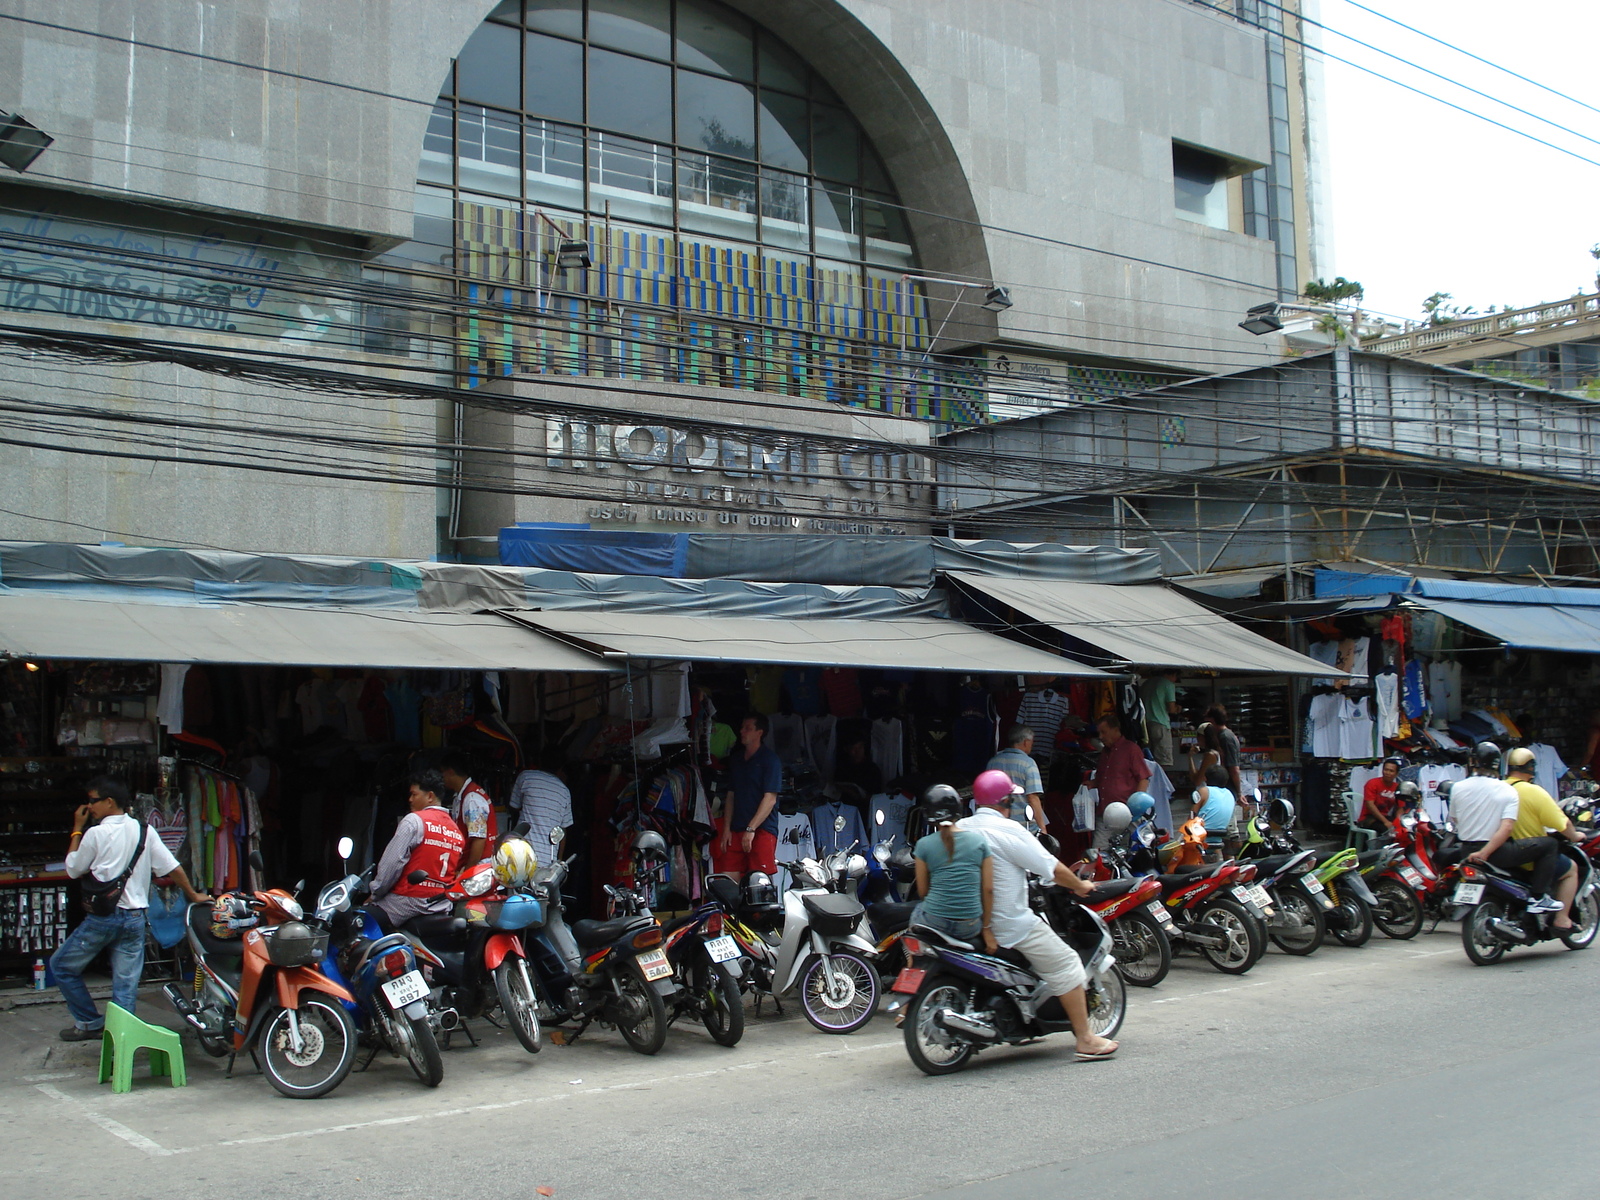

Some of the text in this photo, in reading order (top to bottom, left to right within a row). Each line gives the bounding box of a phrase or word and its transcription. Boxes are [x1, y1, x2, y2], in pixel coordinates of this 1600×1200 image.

[425, 821, 463, 841] Taxi Service
[439, 852, 451, 878] 1
[716, 950, 736, 961] 745
[399, 989, 420, 1004] 897
